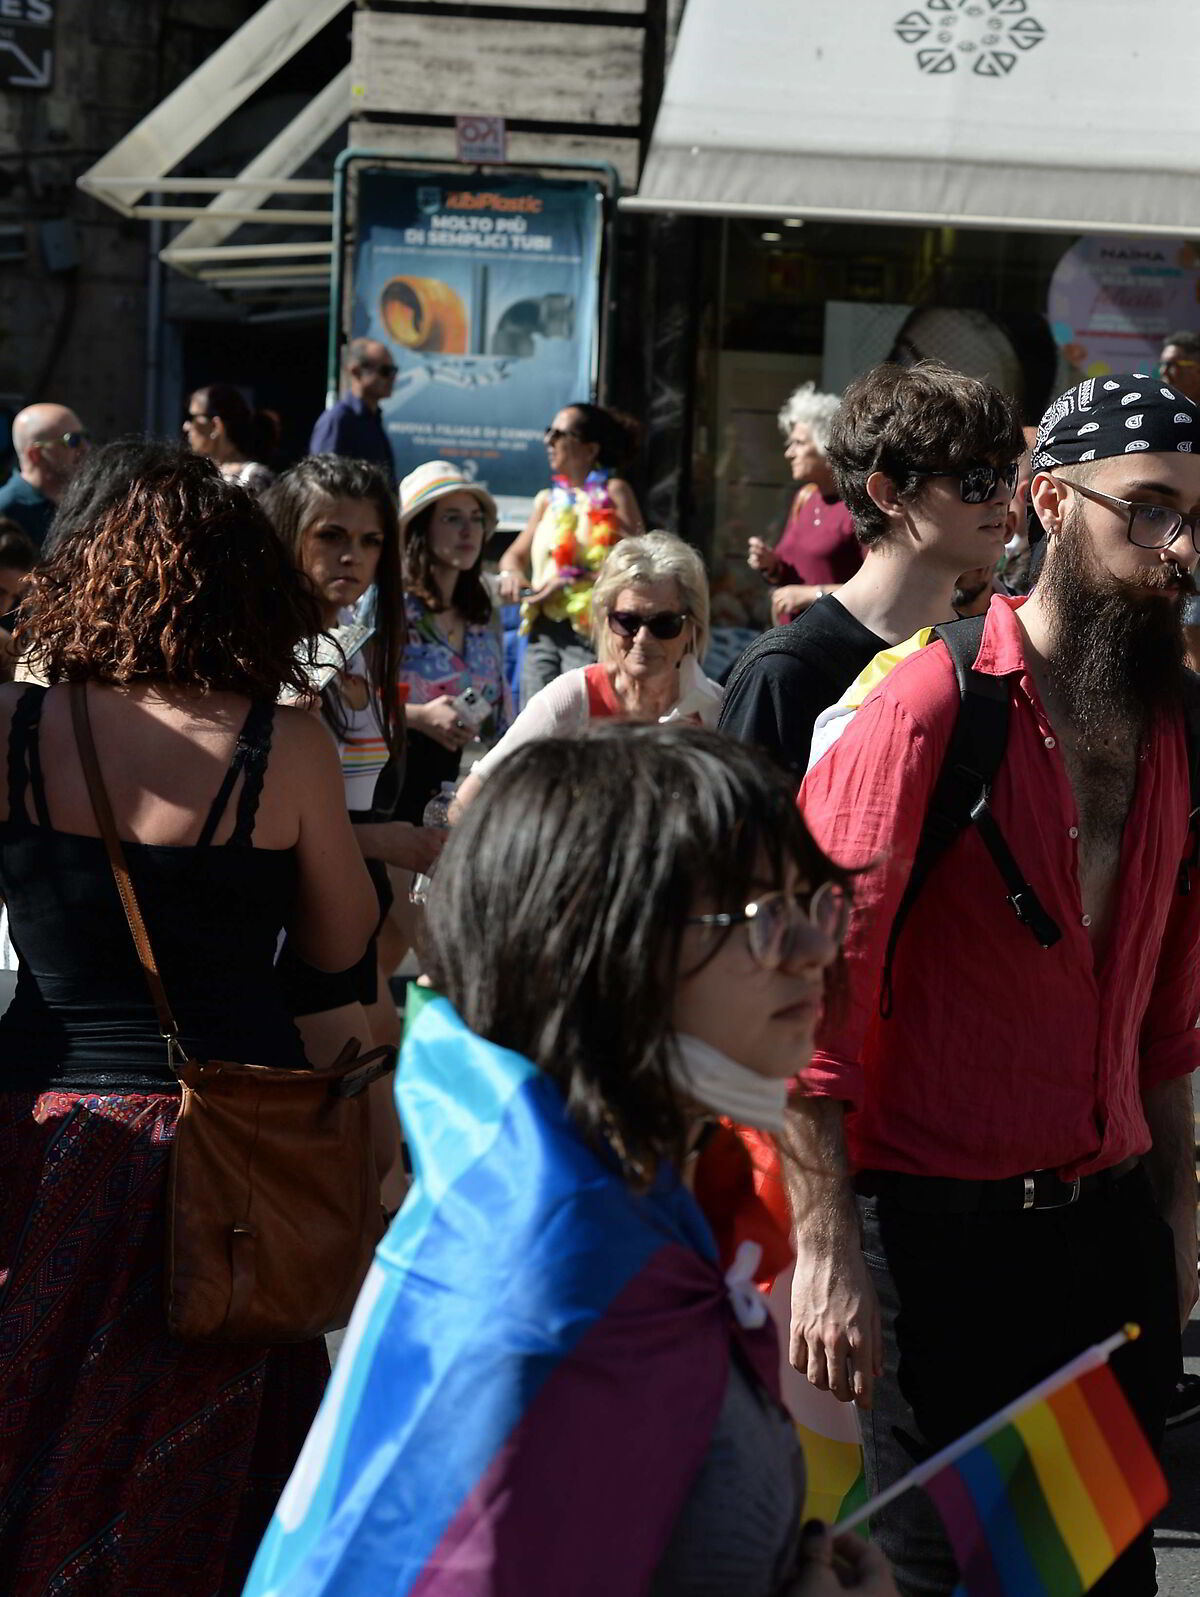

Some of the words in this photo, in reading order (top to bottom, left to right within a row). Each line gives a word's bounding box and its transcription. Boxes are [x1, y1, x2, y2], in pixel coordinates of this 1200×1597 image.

[431, 215, 493, 233] MOLTO
[496, 215, 527, 232] PIÙ
[405, 229, 425, 244] DI
[428, 230, 508, 248] SEMPLICI
[511, 235, 552, 251] TUBI
[500, 428, 544, 441] GENOV
